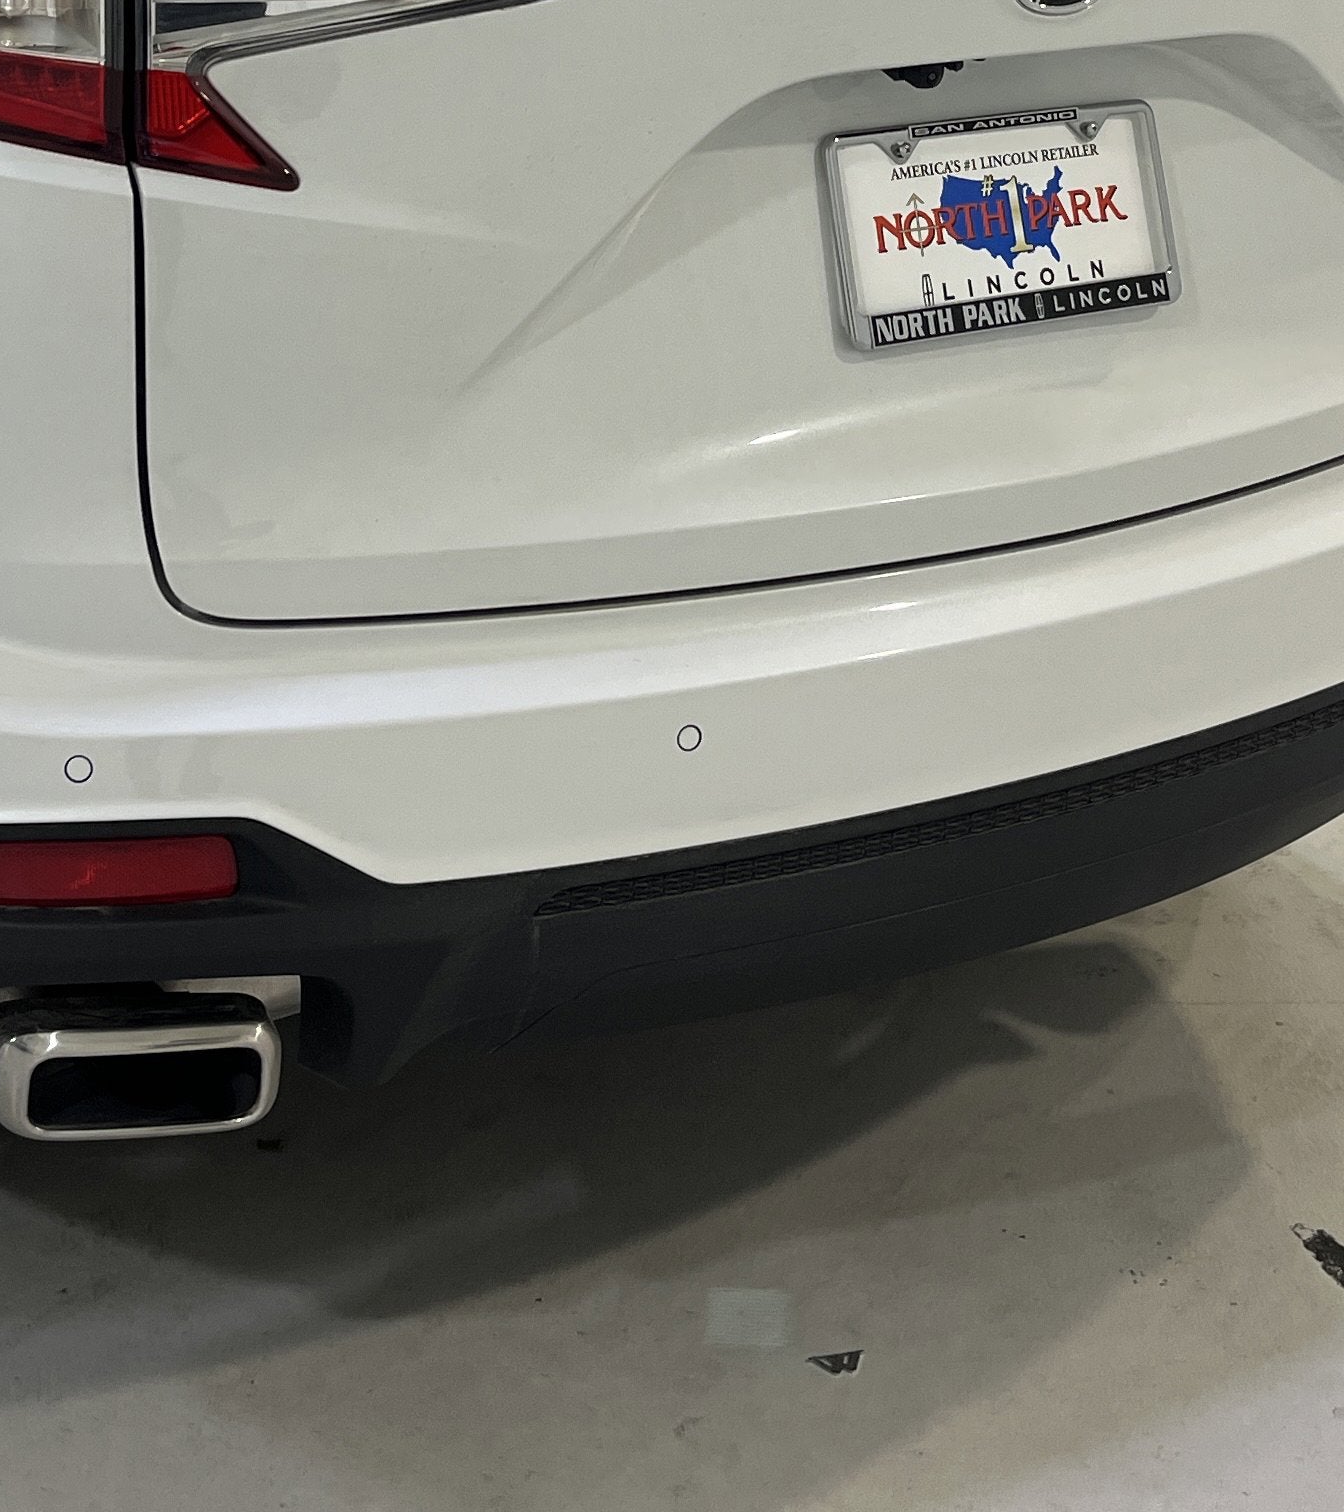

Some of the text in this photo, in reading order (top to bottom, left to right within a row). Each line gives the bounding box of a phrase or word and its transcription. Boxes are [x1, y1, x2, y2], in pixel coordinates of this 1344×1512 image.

[914, 110, 1075, 137] SAN ANTONIO
[891, 143, 1099, 181] AMERICA'S #1 LINCOLN RETAILER
[873, 185, 1128, 253] NORTH PARK
[942, 260, 1104, 301] LINCOLN
[876, 278, 1166, 343] NORTH PARK LINCOLN
